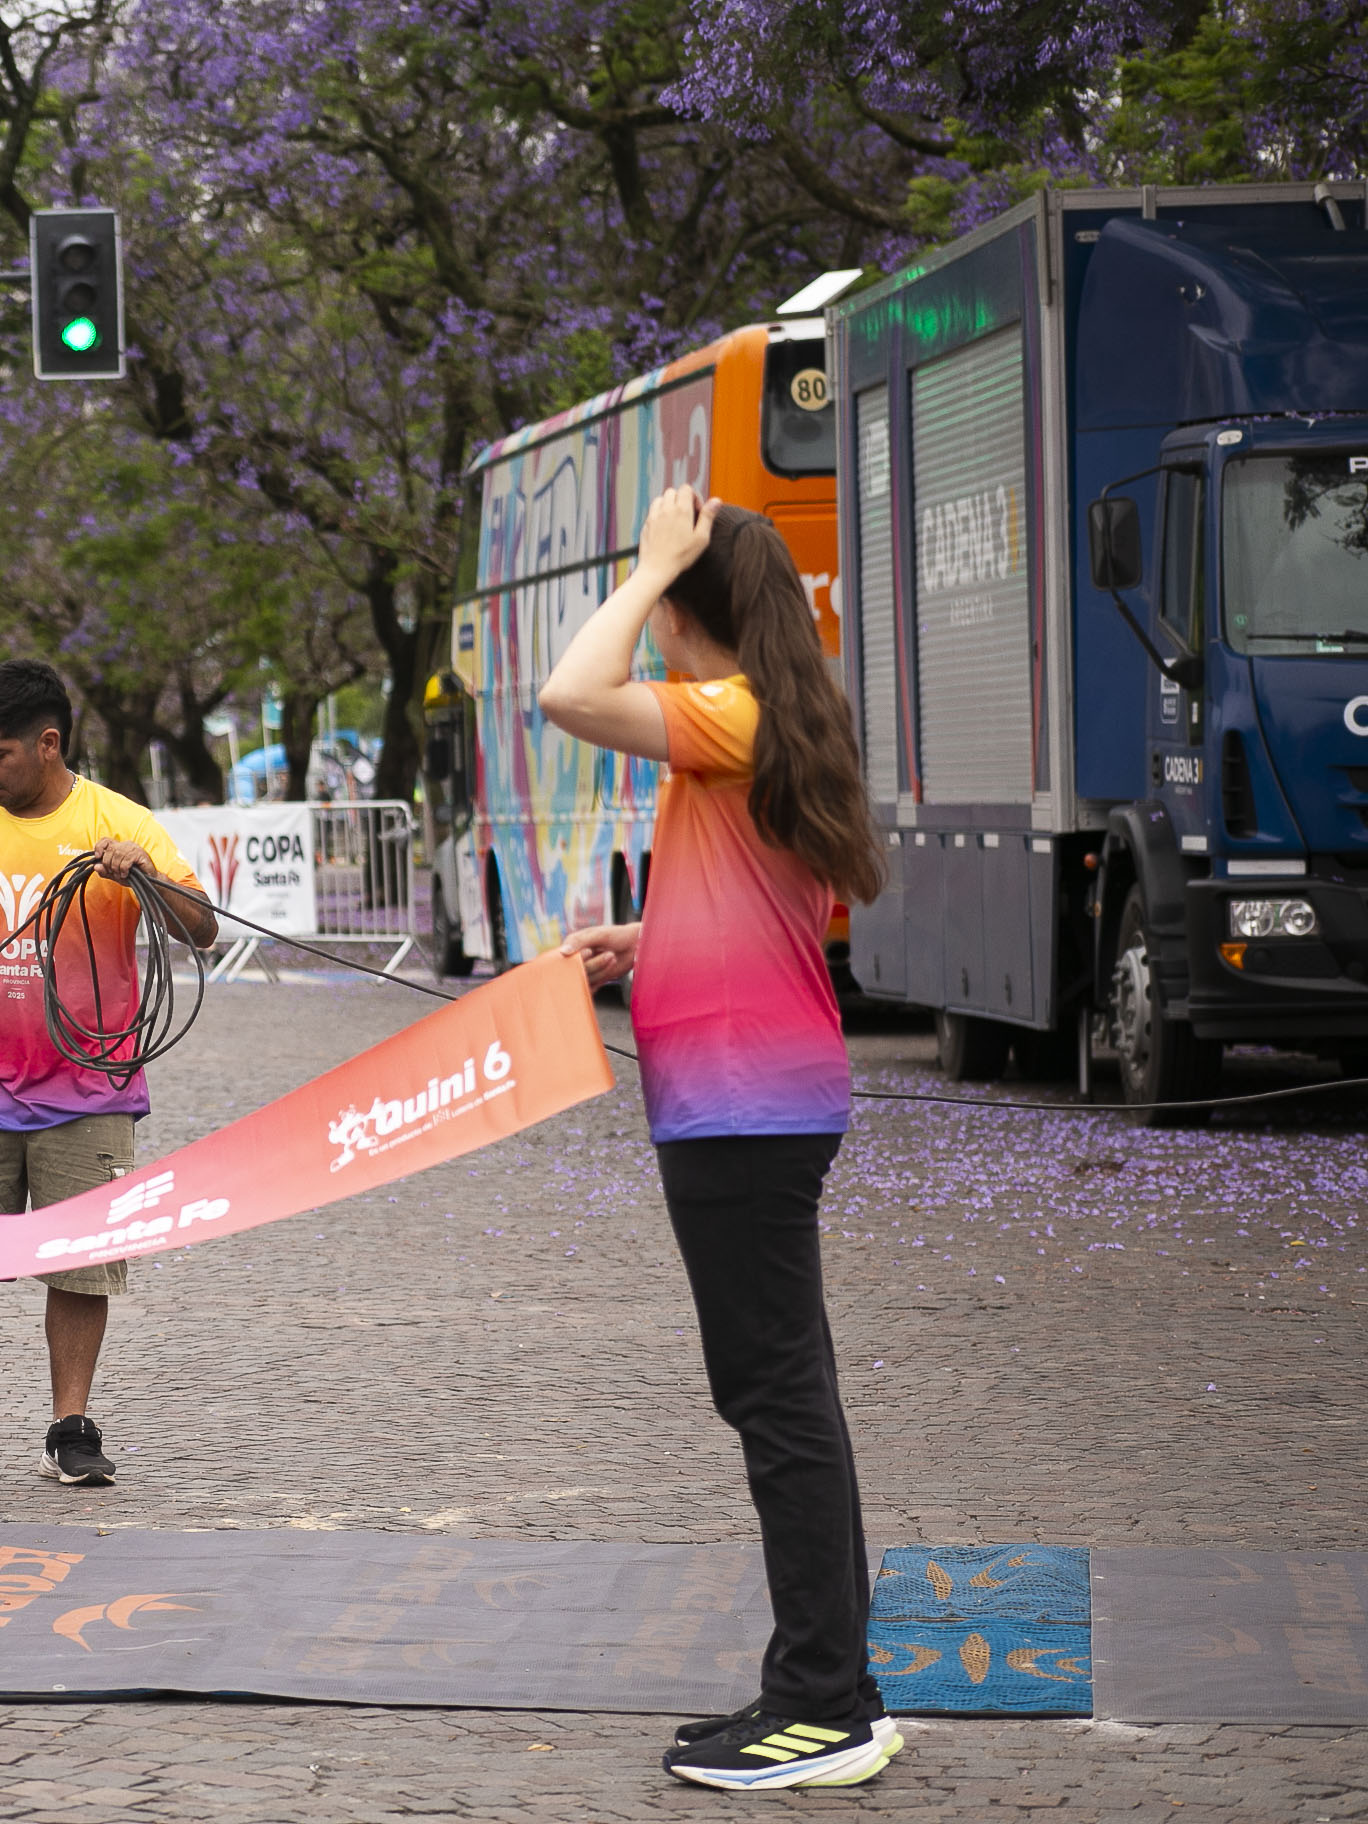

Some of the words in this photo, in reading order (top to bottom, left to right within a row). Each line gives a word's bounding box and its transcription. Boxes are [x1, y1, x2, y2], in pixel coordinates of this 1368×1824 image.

[798, 377, 826, 402] 80
[923, 490, 995, 595] CADENA
[996, 485, 1008, 580] 3
[1165, 756, 1193, 784] CADENA
[1193, 757, 1199, 784] 3
[246, 835, 305, 862] COPA
[254, 871, 287, 887] Santa
[8, 991, 25, 1000] 2025
[375, 1057, 475, 1135] Quini
[483, 1040, 511, 1081] 6
[35, 1216, 173, 1259] Santa
[178, 1198, 230, 1228] Fe
[89, 1237, 167, 1260] PROVINCIA
